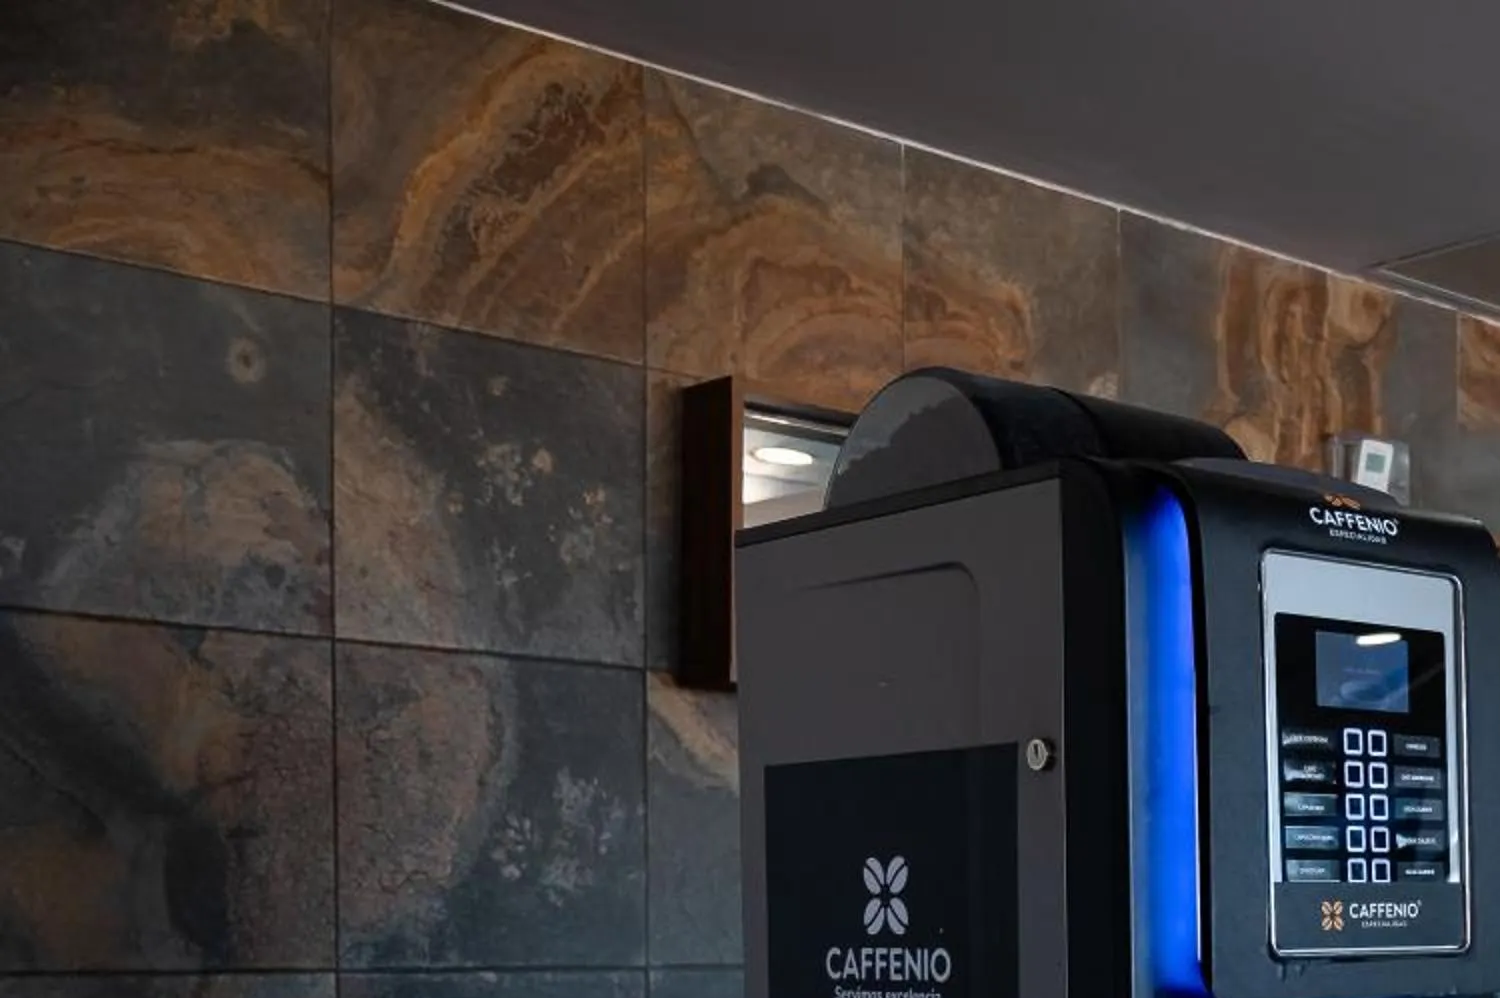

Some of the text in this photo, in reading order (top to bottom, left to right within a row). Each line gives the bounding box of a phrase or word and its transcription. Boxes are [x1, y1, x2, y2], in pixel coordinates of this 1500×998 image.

[1309, 507, 1398, 535] CAFFENIO
[1349, 903, 1419, 918] CAFFENIO
[826, 947, 951, 982] CAFFENIO
